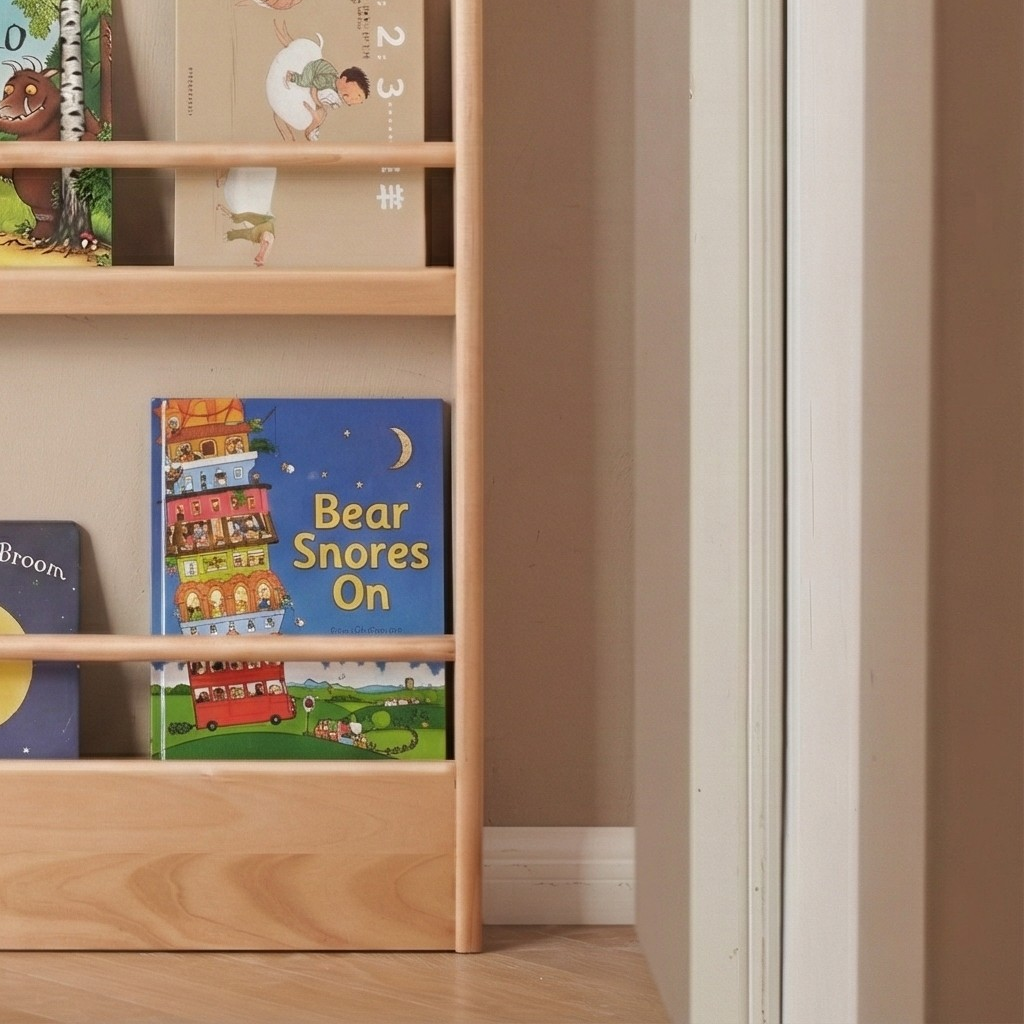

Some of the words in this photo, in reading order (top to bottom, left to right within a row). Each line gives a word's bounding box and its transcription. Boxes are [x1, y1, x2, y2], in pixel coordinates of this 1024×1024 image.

[314, 493, 409, 530] Bear
[293, 532, 430, 570] Snores
[332, 573, 390, 611] On
